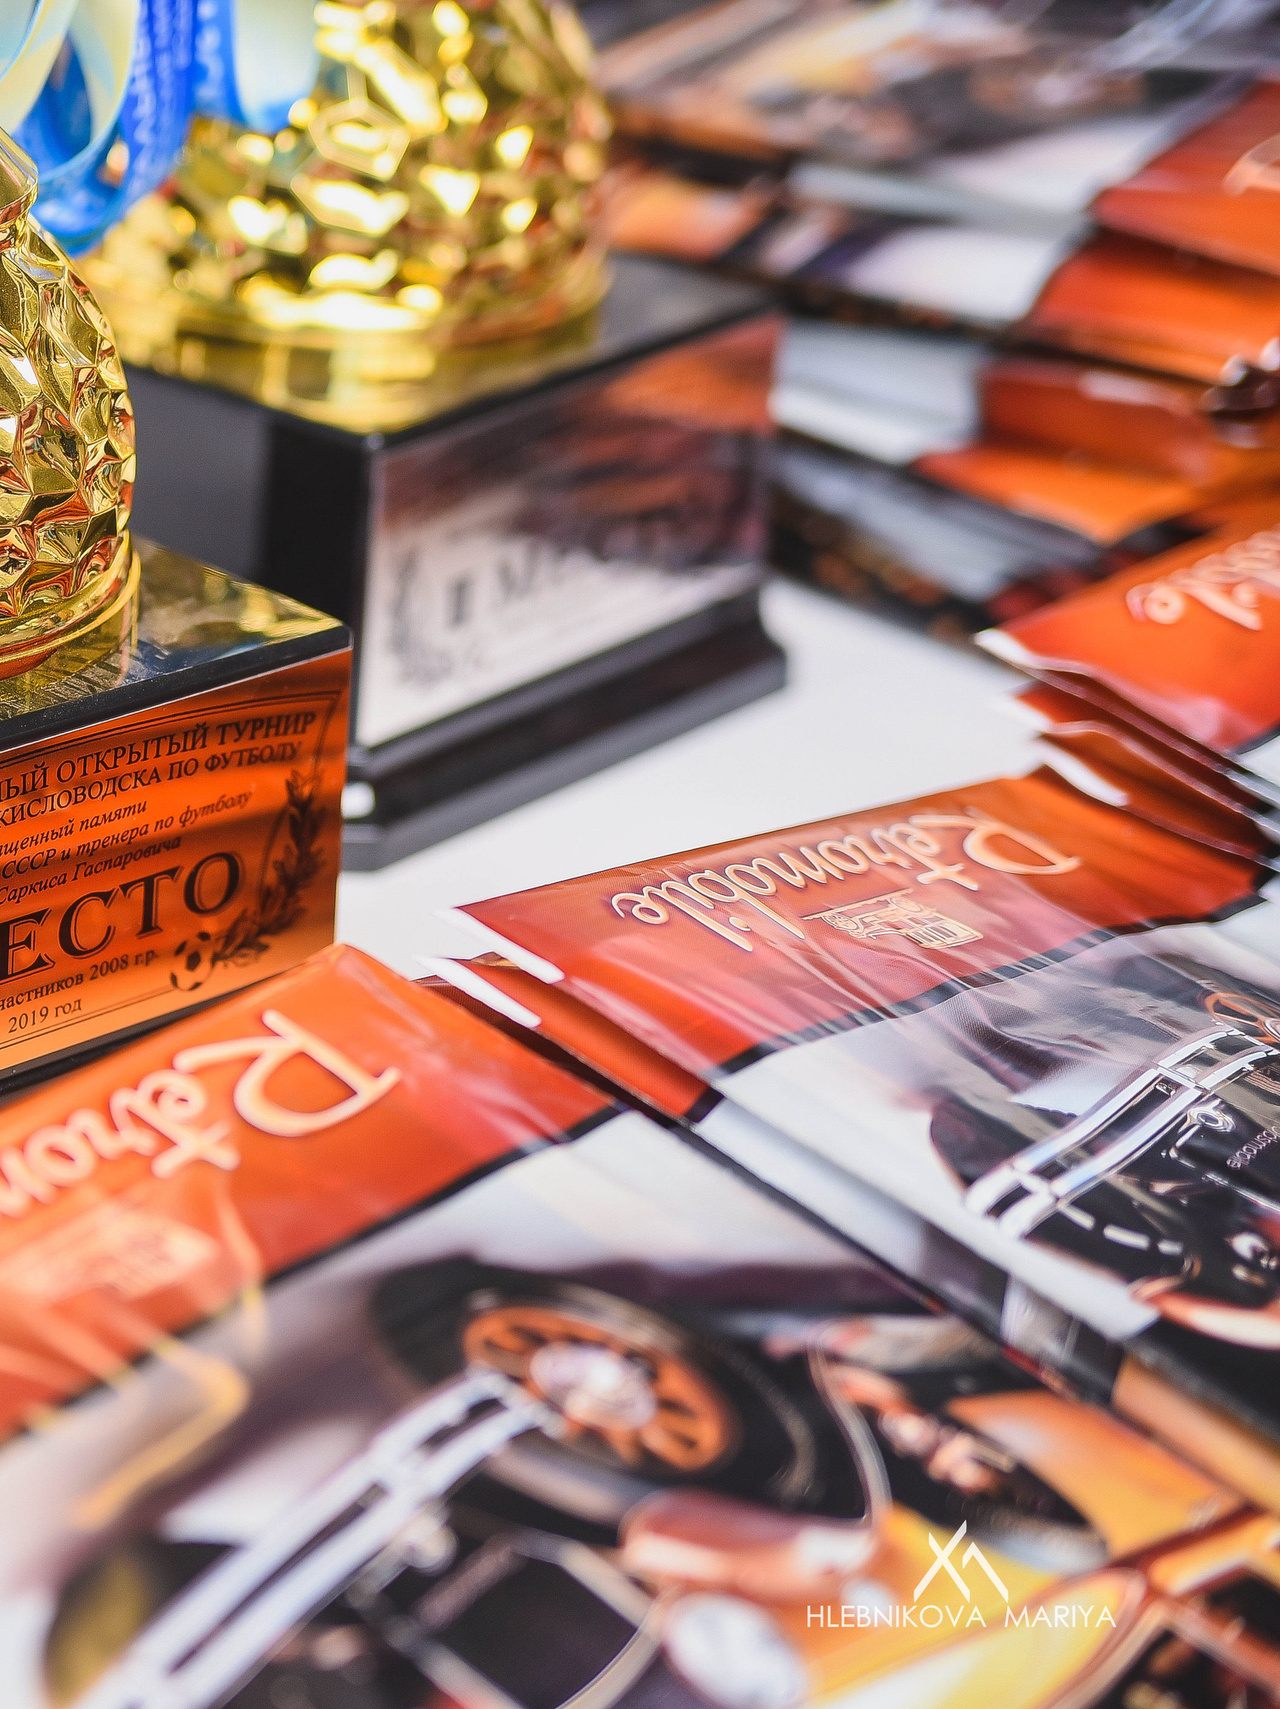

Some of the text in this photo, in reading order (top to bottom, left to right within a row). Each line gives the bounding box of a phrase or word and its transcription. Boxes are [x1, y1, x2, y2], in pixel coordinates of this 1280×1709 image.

[56, 721, 210, 783] ОТКРЫТЫЙ
[216, 711, 316, 746] ТУРНИР
[167, 758, 199, 781] ПО
[204, 741, 303, 772] ФУТБОЛУ
[1, 848, 57, 880] СССР
[61, 847, 72, 862] и
[76, 823, 149, 858] тренера
[154, 815, 174, 833] по
[179, 790, 253, 828] футболу
[79, 801, 147, 832] памяти
[72, 836, 182, 882] Гаспаровича
[610, 807, 1081, 952] Retromobile
[89, 954, 129, 982] 2008
[134, 949, 159, 967] г.р.
[8, 998, 82, 1034] 2019 год
